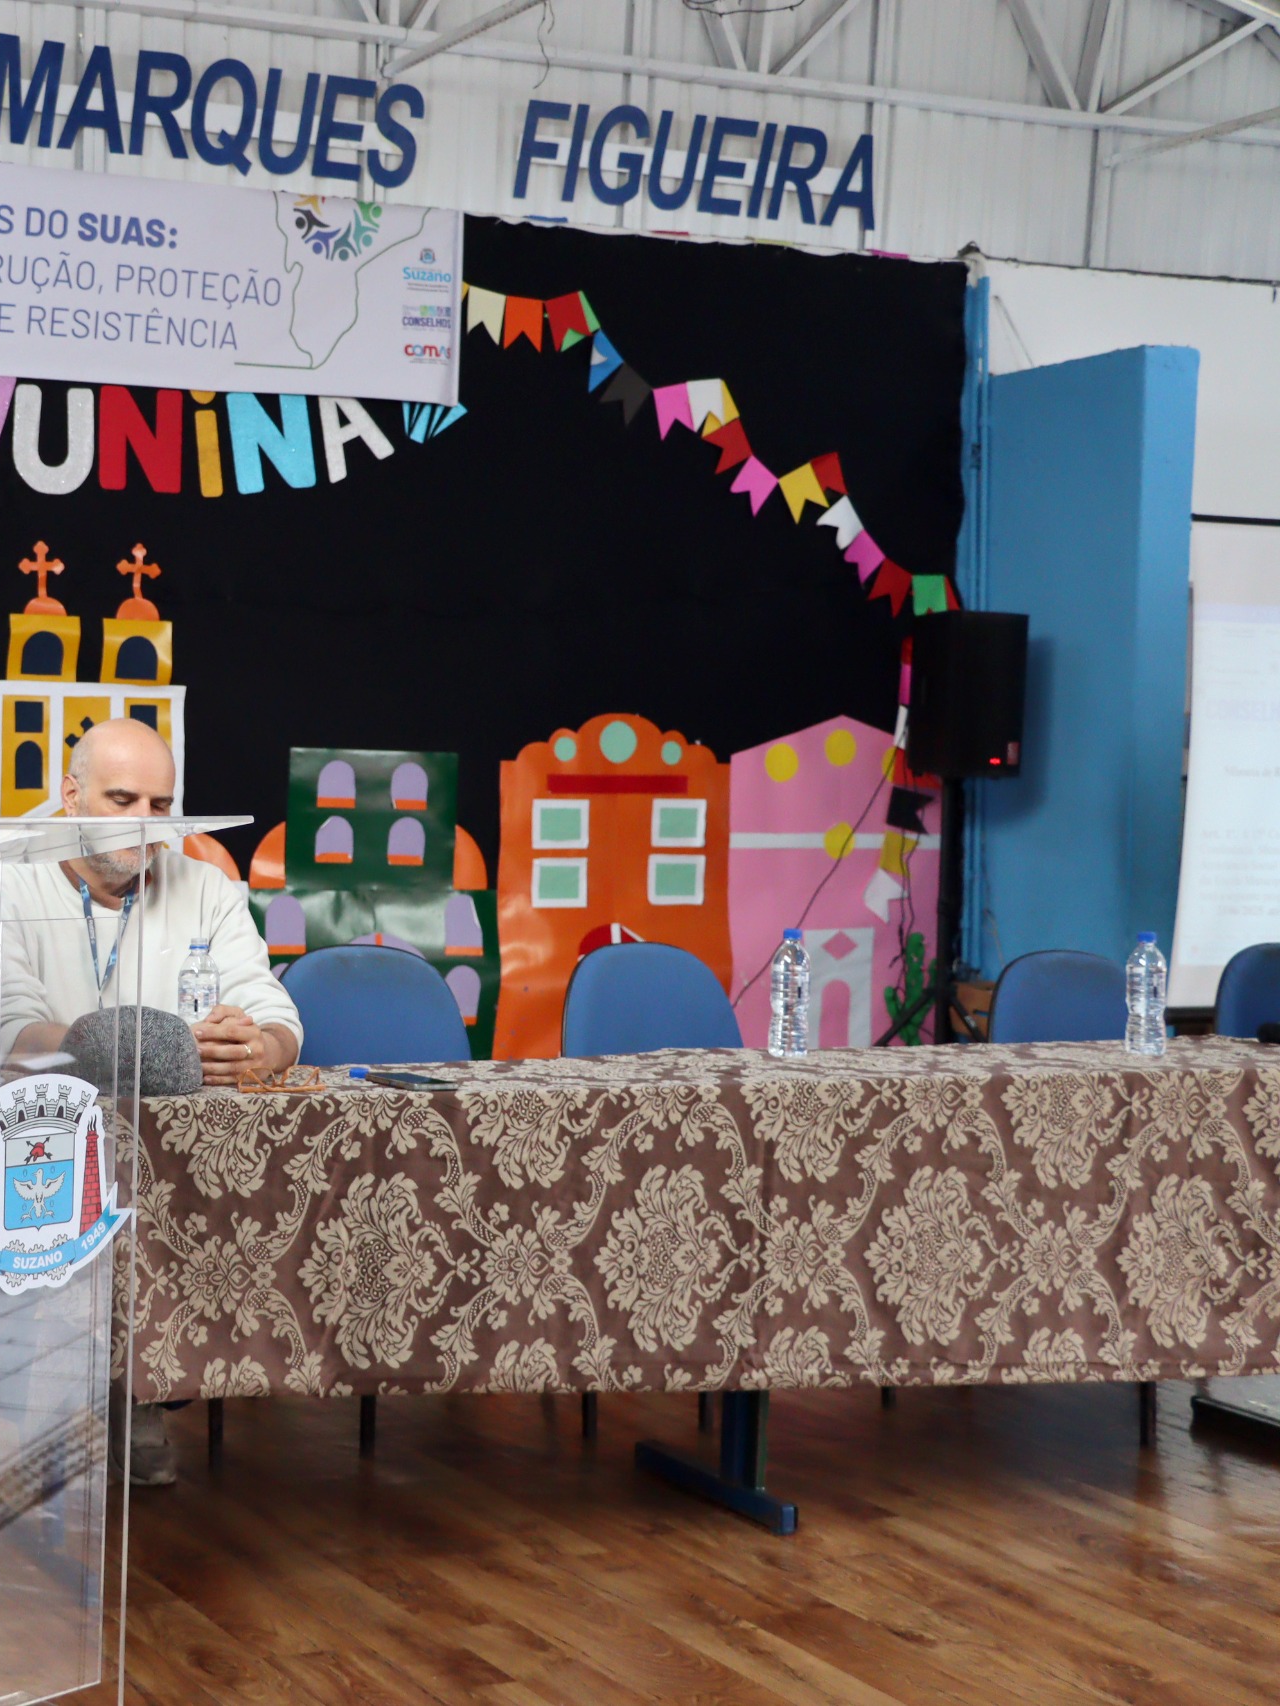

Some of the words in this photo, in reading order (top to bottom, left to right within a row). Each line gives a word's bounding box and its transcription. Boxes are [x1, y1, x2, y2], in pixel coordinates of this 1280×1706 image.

[512, 98, 877, 231] FIGUEIRA
[25, 206, 69, 240] DO
[77, 212, 178, 249] SUAS:
[115, 263, 281, 310] PROTEÇÃO
[402, 266, 452, 283] Suzano
[27, 305, 238, 350] RESISTÊNCIA
[12, 1250, 63, 1270] SUZANO
[81, 1221, 106, 1251] 1949
